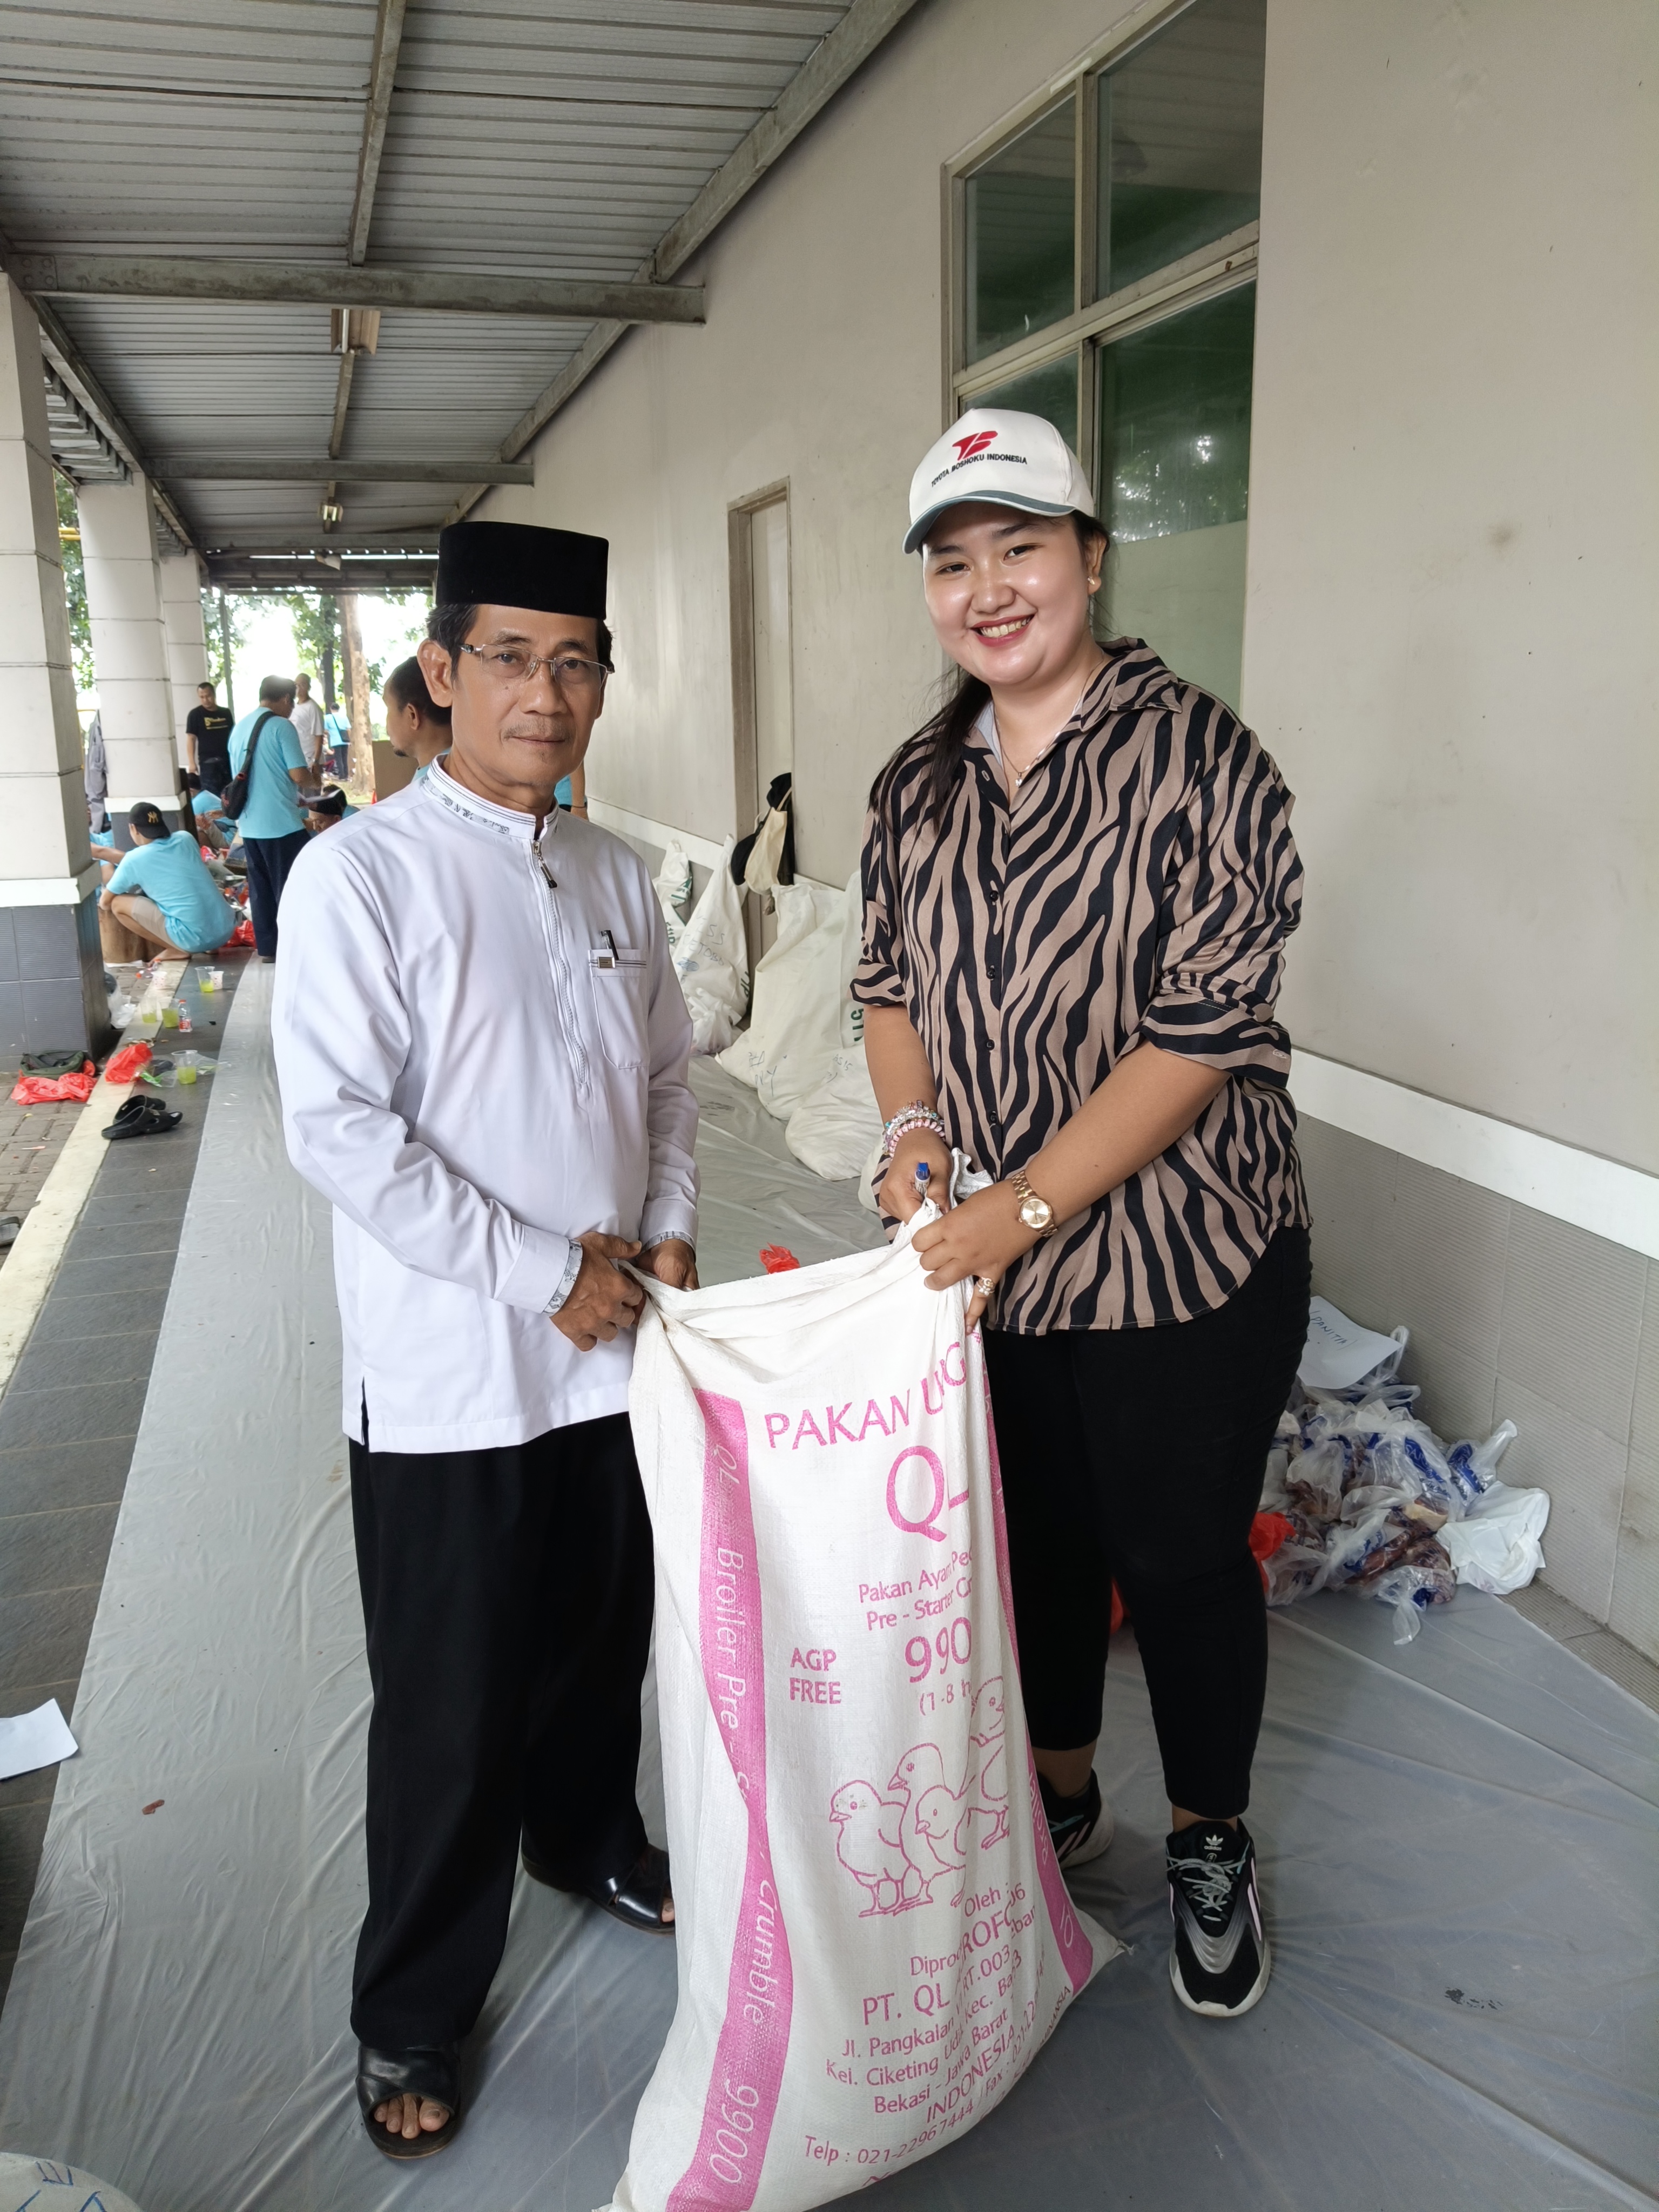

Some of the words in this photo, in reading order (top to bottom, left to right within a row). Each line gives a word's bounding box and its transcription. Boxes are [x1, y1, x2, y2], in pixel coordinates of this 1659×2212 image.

[931, 468, 949, 488] TOYOTA
[951, 454, 984, 472] BOSHOKU
[987, 453, 1027, 465] INDONESIA
[764, 1388, 911, 1450] PAKAN
[715, 1547, 745, 1661] Broiler
[859, 1581, 913, 1603] Pakan
[866, 1610, 897, 1631] Pre
[914, 1589, 954, 1620] Starter
[790, 1647, 837, 1671] AGP
[716, 1672, 746, 1730] Pre
[790, 1677, 842, 1704] FREE
[965, 1887, 1001, 1918] Oleh
[743, 1879, 779, 2025] Crumble
[862, 1992, 902, 2026] PT.
[914, 1982, 950, 2017] QL
[842, 2039, 861, 2058] Jl.
[869, 2016, 954, 2057] Pangkalan
[866, 2056, 939, 2086] Ciketing
[874, 2083, 930, 2113] Bekasi
[945, 2045, 970, 2086] Jawa
[971, 2007, 1008, 2047] Barat
[926, 2024, 1014, 2123] INDONESIA
[804, 2134, 839, 2166] Telp
